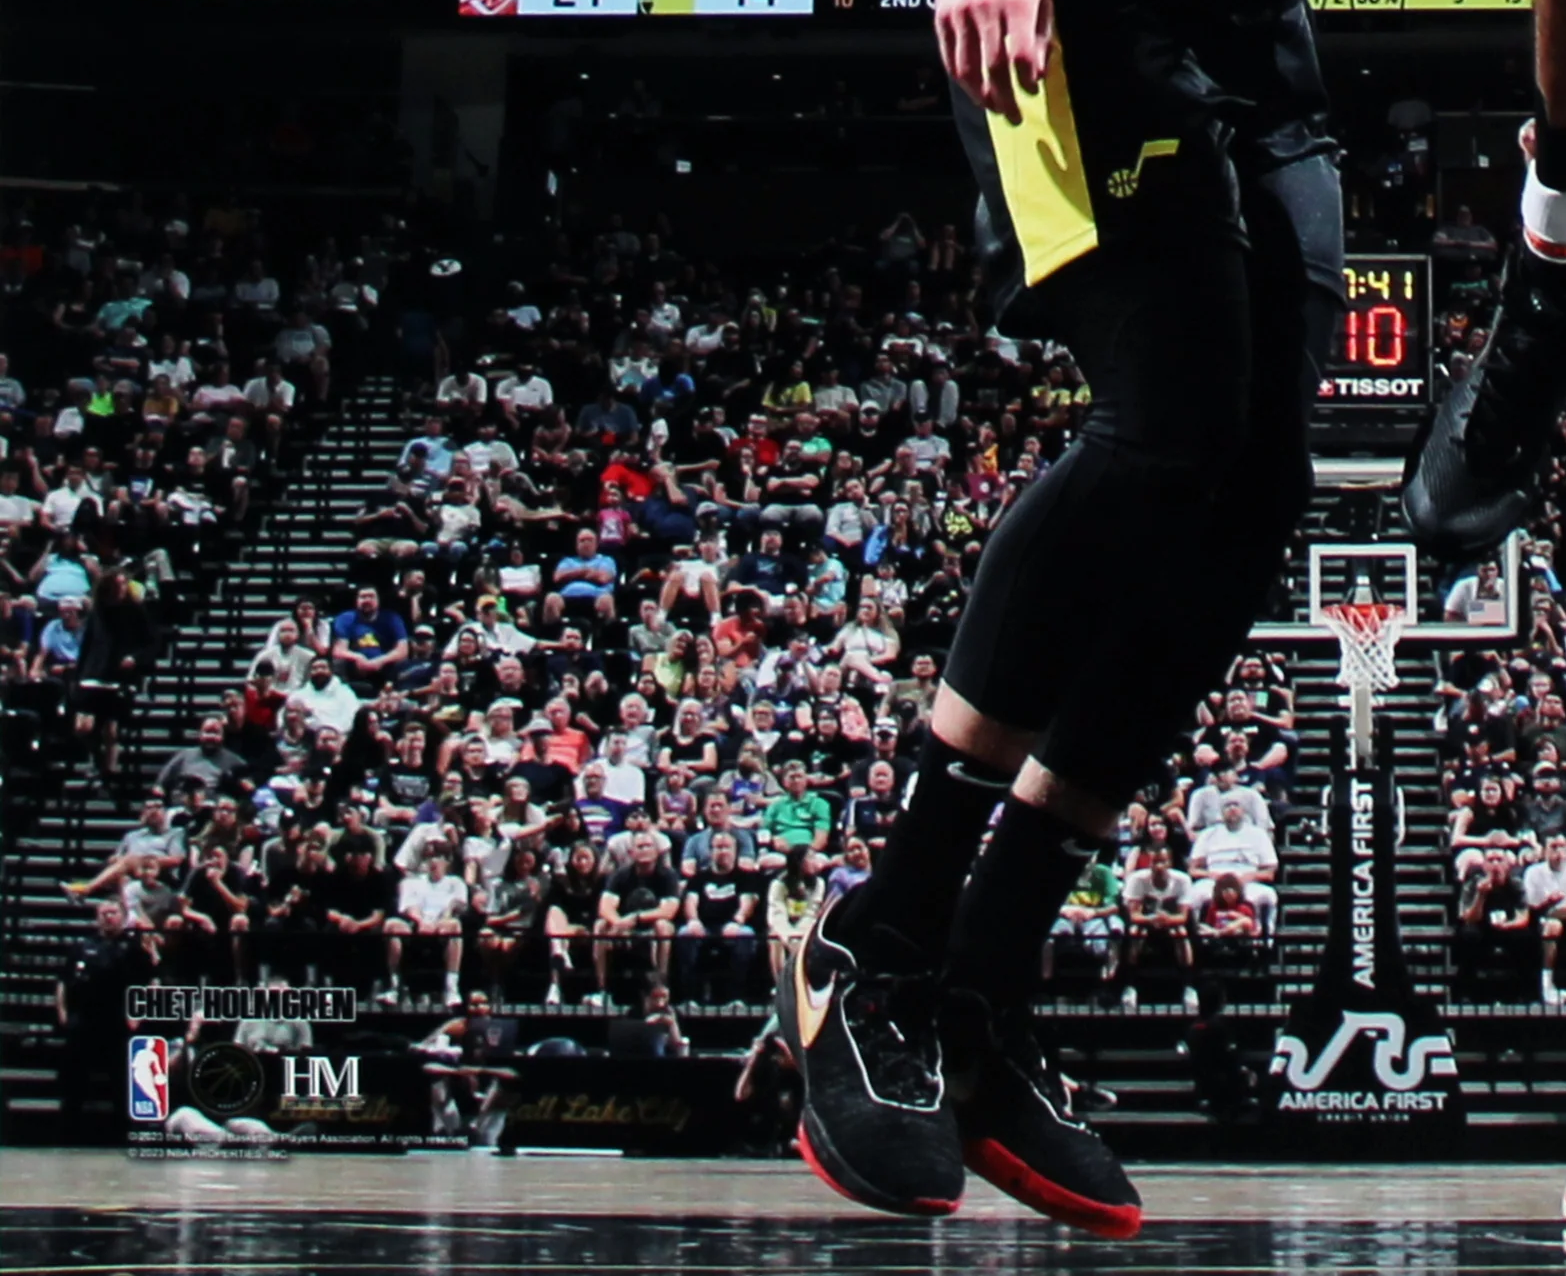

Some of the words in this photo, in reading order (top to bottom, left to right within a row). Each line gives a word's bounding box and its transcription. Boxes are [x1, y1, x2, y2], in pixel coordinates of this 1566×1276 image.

[1345, 306, 1403, 366] 10
[1335, 378, 1424, 396] TISSOT
[1351, 778, 1374, 855] FIRST
[1351, 860, 1375, 989] AMERICA
[1278, 1091, 1379, 1110] AMERICA
[1382, 1091, 1448, 1110] FIRST
